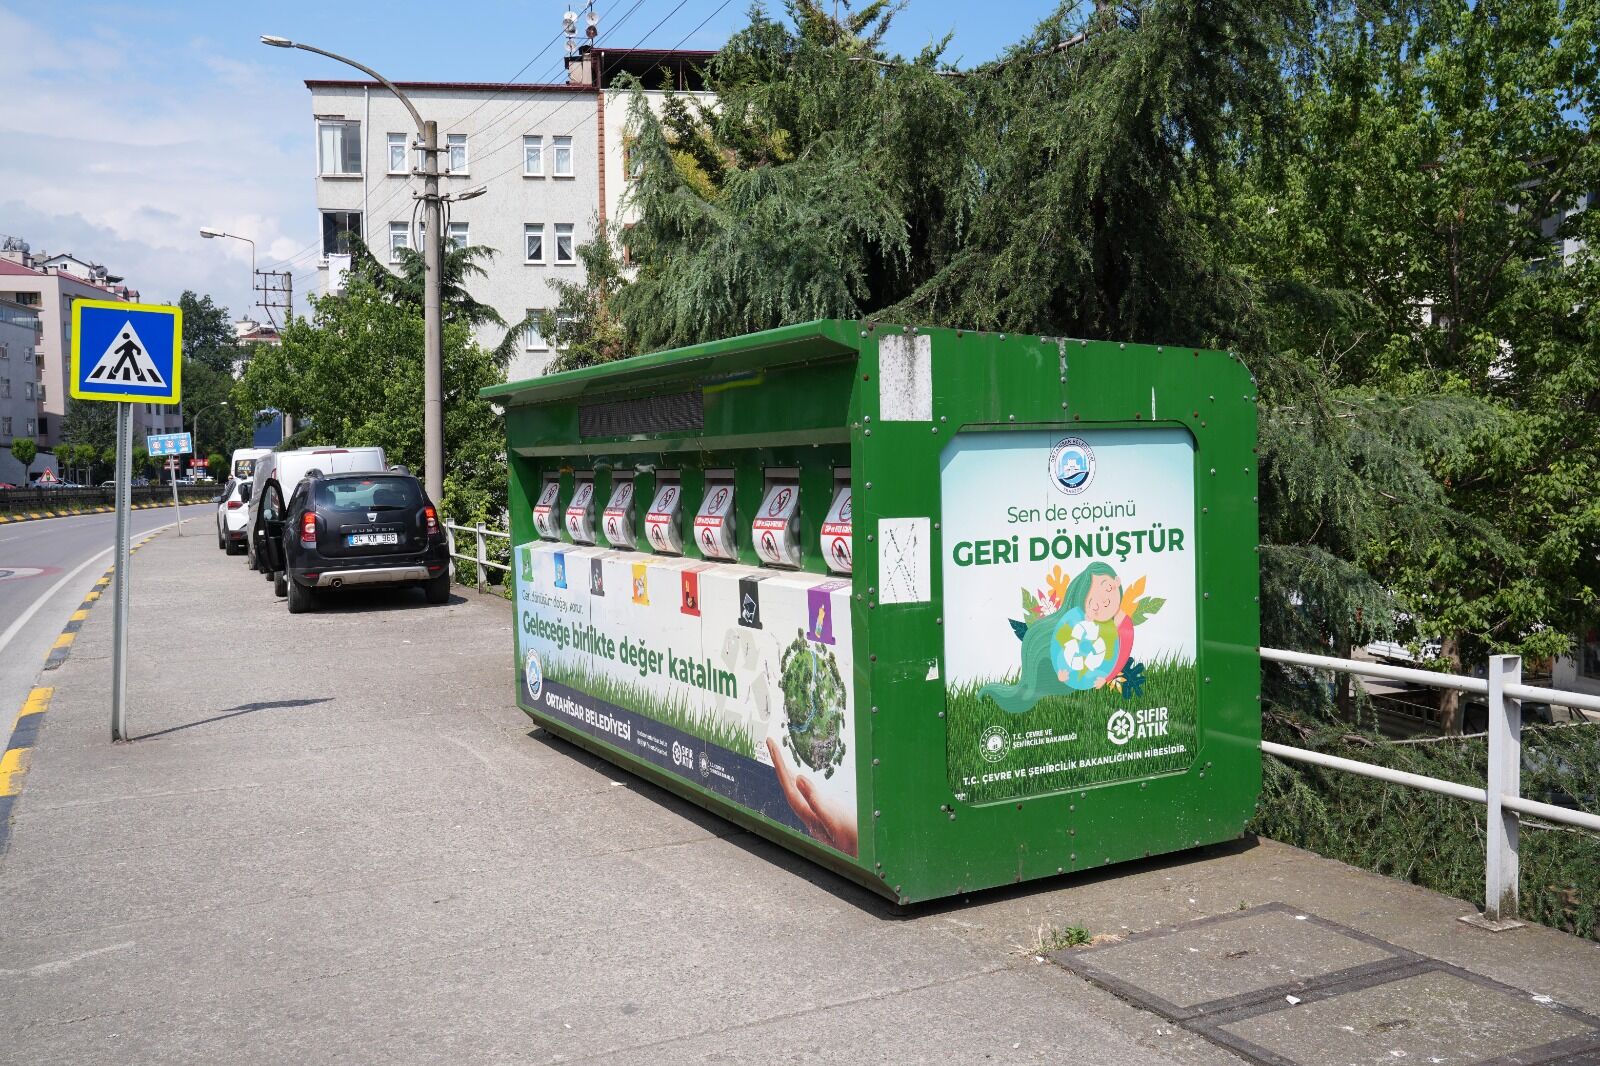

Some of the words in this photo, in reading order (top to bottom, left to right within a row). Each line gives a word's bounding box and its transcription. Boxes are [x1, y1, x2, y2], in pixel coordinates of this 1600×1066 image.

[1008, 506, 1040, 524] Sen
[1046, 504, 1067, 521] de
[1072, 500, 1136, 525] çöpünü
[354, 535, 363, 543] 34
[1030, 523, 1184, 562] DÖNÜŞTÜR
[522, 610, 570, 650] Geleceğe
[572, 620, 615, 660] birlikte
[619, 636, 664, 676] değer
[668, 648, 738, 698] katalım
[546, 691, 584, 721] ORTAHİSAR
[585, 709, 631, 741] BELEDİYESİ
[1136, 706, 1168, 724] SIFIR
[1025, 730, 1044, 738] ÇEVRE
[1137, 720, 1168, 738] ATIK
[1012, 737, 1045, 749] ŞEHİRCİLİK
[1045, 731, 1078, 744] BAKANLIĞI
[963, 776, 980, 786] T.C.
[982, 770, 1012, 785] ÇEVRE
[1014, 768, 1026, 778] VE
[1028, 758, 1077, 778] ŞEHİRCİLİK
[1079, 750, 1142, 768] BAKANLIĞI'NIN
[1144, 744, 1187, 759] HİBESİDİR.
